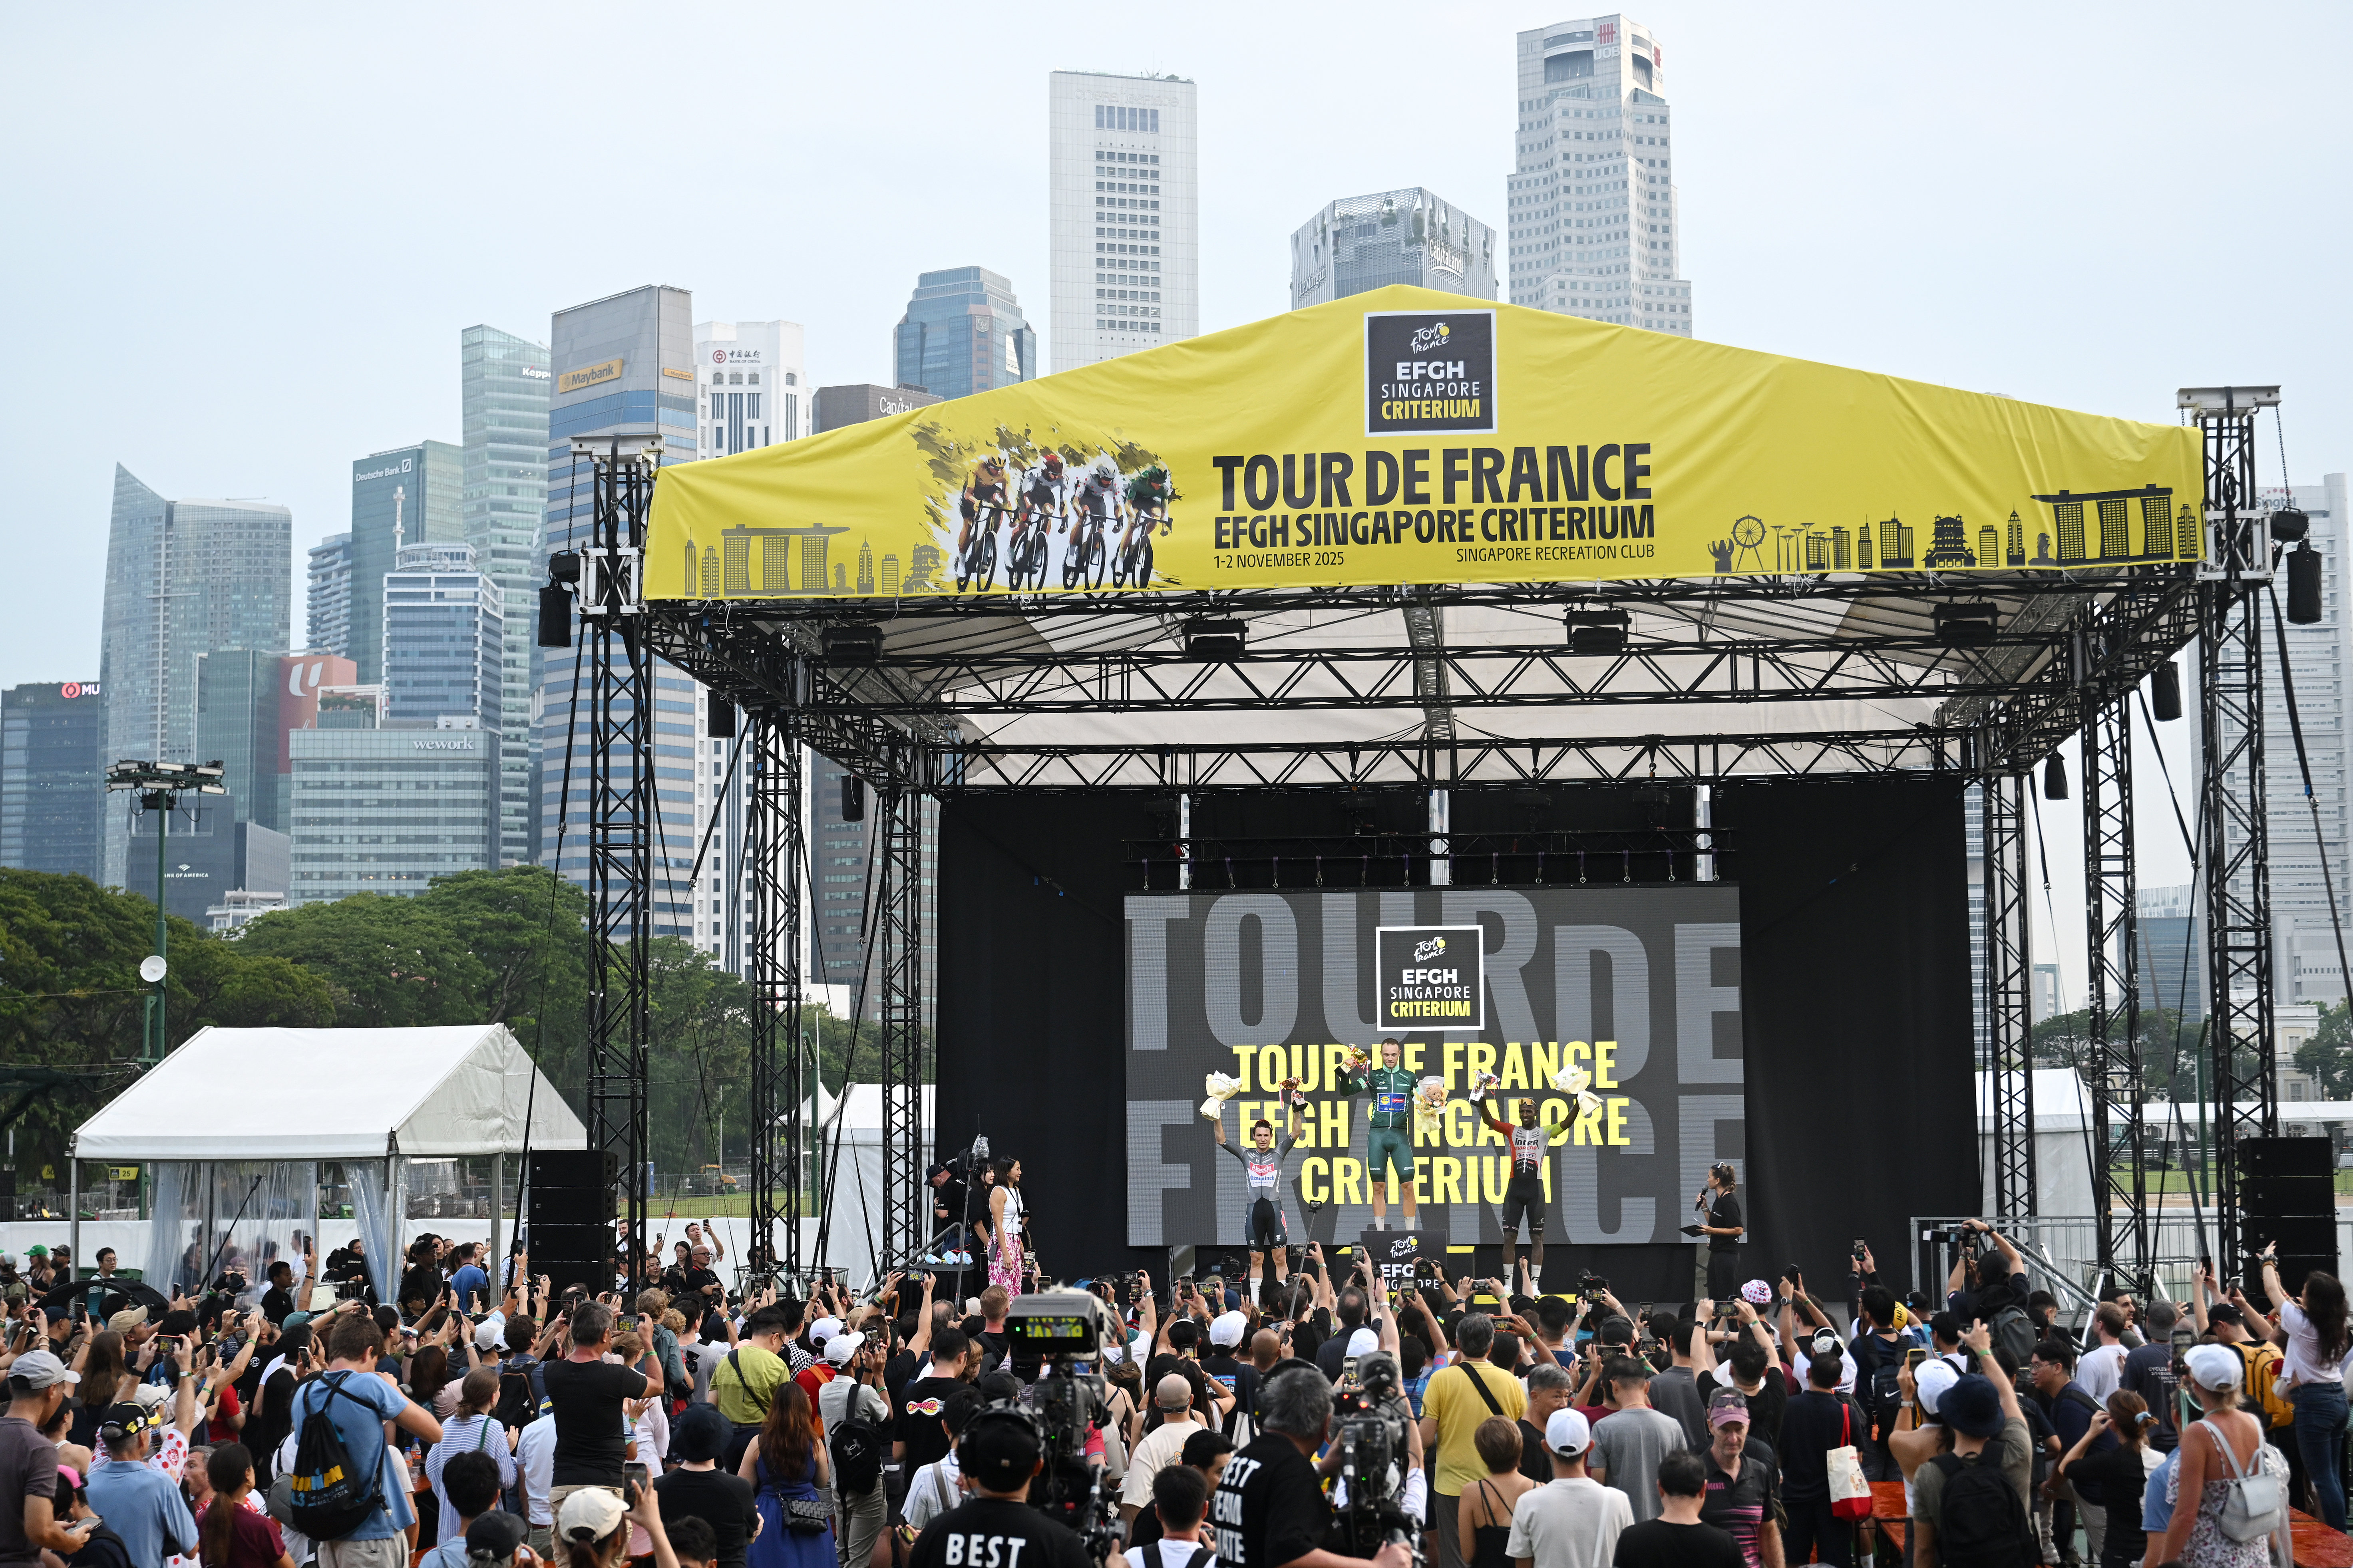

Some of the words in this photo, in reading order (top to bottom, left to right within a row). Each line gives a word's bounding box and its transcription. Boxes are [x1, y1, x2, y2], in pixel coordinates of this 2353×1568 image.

[1593, 46, 1621, 60] UOB
[1430, 239, 1462, 274] CapitaLand
[571, 364, 614, 386] Maybank
[671, 370, 692, 379] Maybank
[1396, 361, 1464, 380] EFGH
[1381, 382, 1480, 398] SINGAPORE
[1382, 399, 1480, 420] CRITERIUM
[356, 469, 384, 482] Deutsche
[385, 466, 400, 476] Bank
[1213, 452, 1353, 511] TOUR
[1366, 449, 1430, 506] DE
[1442, 443, 1651, 504] FRANCE
[1215, 514, 1289, 549] EFGH
[1296, 509, 1474, 547] SINGAPORE
[1481, 505, 1654, 542] CRITERIUM
[1214, 554, 1233, 568] 1-2
[1237, 552, 1311, 568] NOVEMBER
[1314, 552, 1344, 566] 2025
[1456, 547, 1531, 562] SINGAPORE
[1536, 546, 1616, 560] RECREATION
[1621, 544, 1654, 558] CLUB
[413, 736, 474, 750] wework
[1402, 969, 1457, 984] EFGH
[1390, 986, 1470, 999] SINGAPORE
[1390, 1000, 1470, 1017] CRITERIUM
[1252, 1164, 1272, 1173] Alpecin
[1380, 1264, 1415, 1278] EFG
[945, 1533, 1026, 1568] BEST
